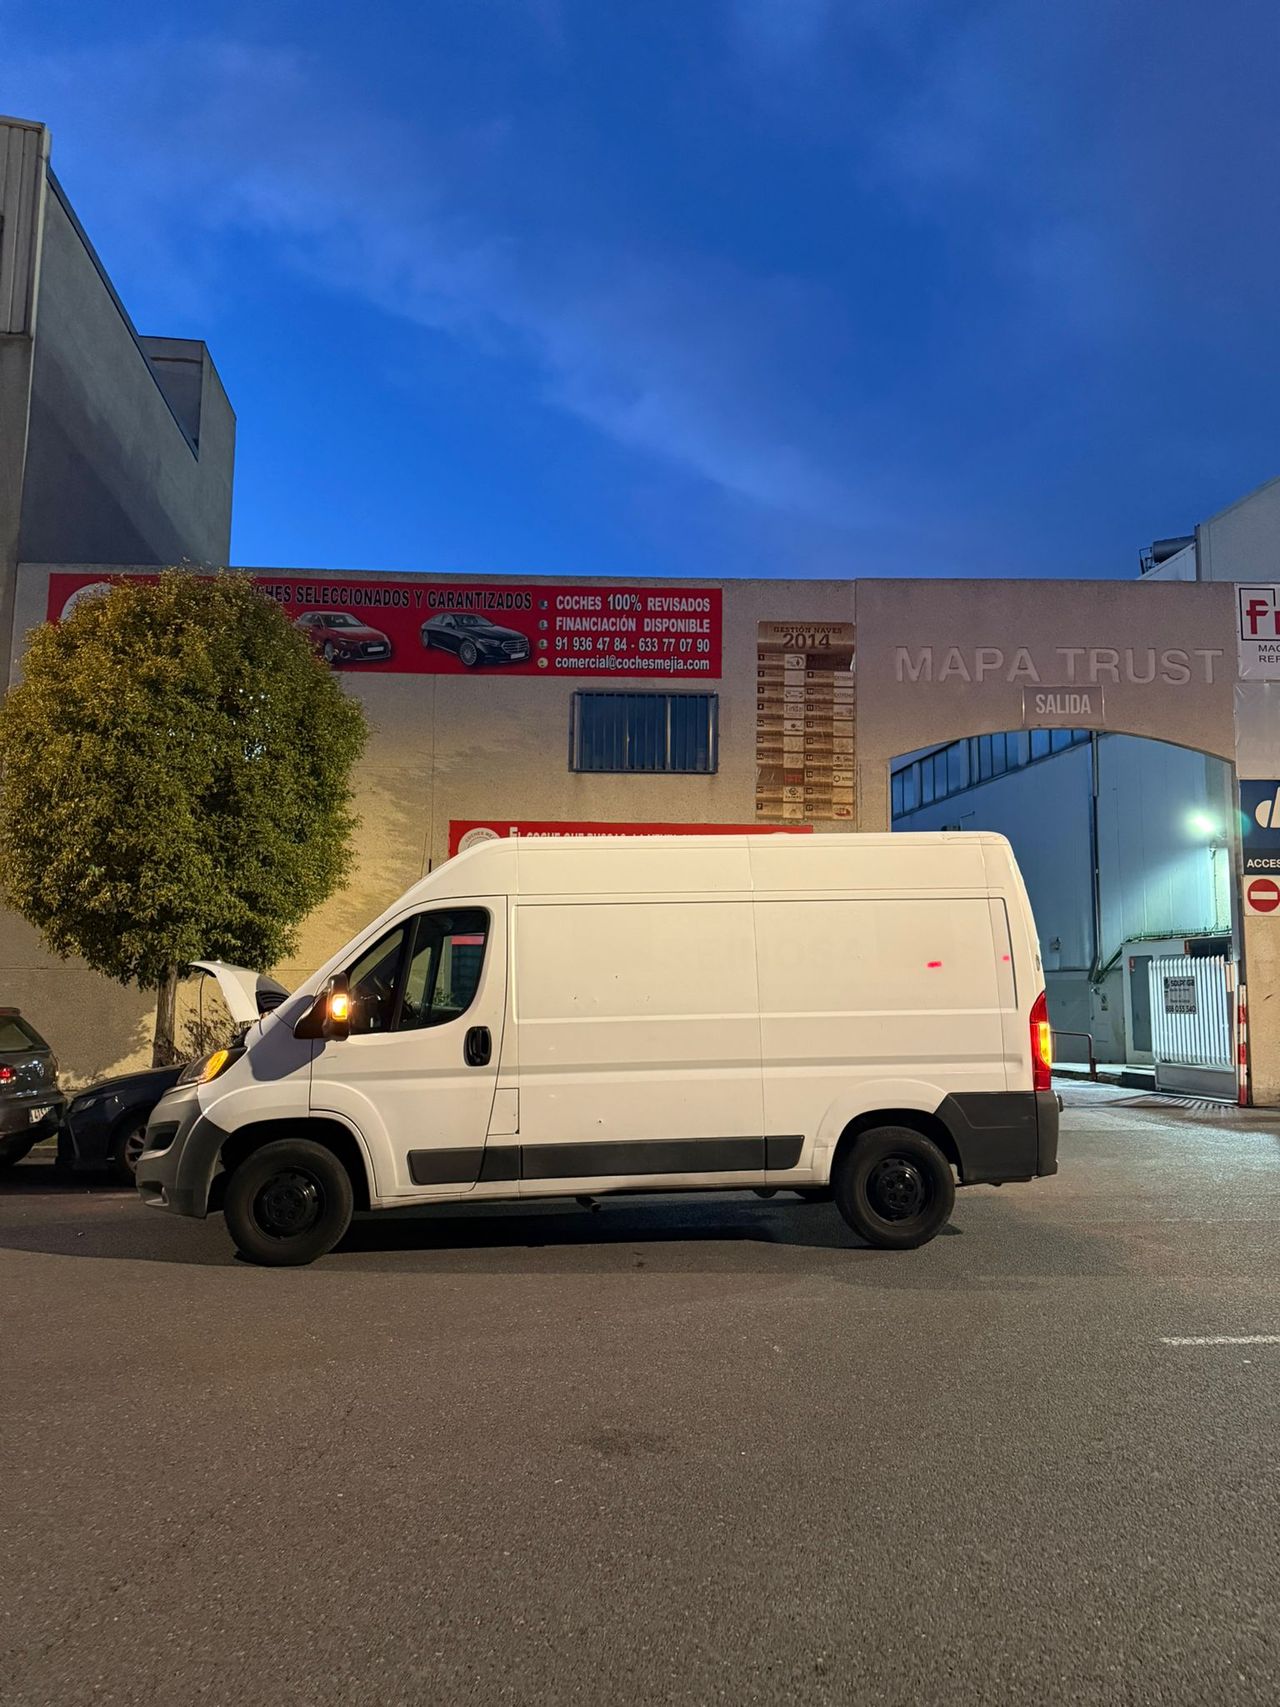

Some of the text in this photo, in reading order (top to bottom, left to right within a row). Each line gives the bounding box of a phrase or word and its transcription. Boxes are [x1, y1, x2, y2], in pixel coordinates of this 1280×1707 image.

[296, 586, 409, 607] SELECCIONADOS
[415, 590, 424, 608] Y
[428, 590, 532, 611] GARANTIZADOS
[556, 594, 710, 612] COCHES 100% REVISADOS
[556, 615, 710, 633] FINANCIACIÓN DISPONIBLE
[555, 637, 567, 651] 91
[573, 637, 593, 651] 936
[596, 637, 610, 651] 47
[614, 637, 627, 651] 84
[638, 638, 659, 652] 633
[662, 638, 676, 652] 77
[679, 638, 693, 652] 07
[696, 638, 710, 652] 90
[783, 633, 832, 650] 2014
[555, 654, 710, 673] comercial@cochesmejia.com
[895, 646, 1224, 684] MAPA TRUST
[1035, 693, 1091, 715] SALIDA
